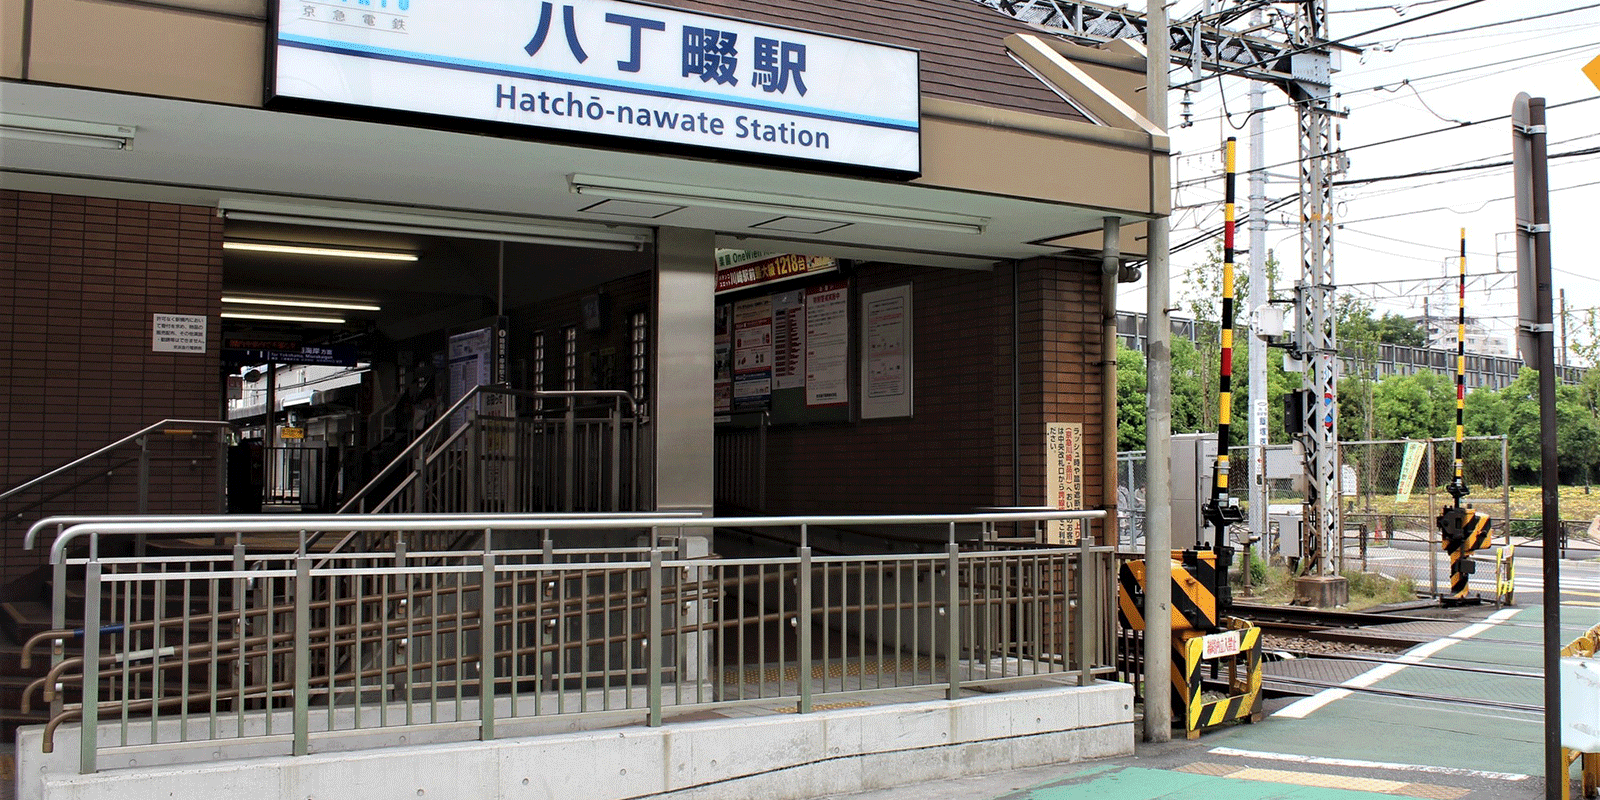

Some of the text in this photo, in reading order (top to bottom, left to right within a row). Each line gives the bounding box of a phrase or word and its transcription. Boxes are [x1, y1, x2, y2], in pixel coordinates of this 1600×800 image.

[302, 5, 406, 31] 京急電鉄
[524, 1, 807, 97] 八丁畷駅
[495, 84, 830, 149] Hatchō-nawate Station
